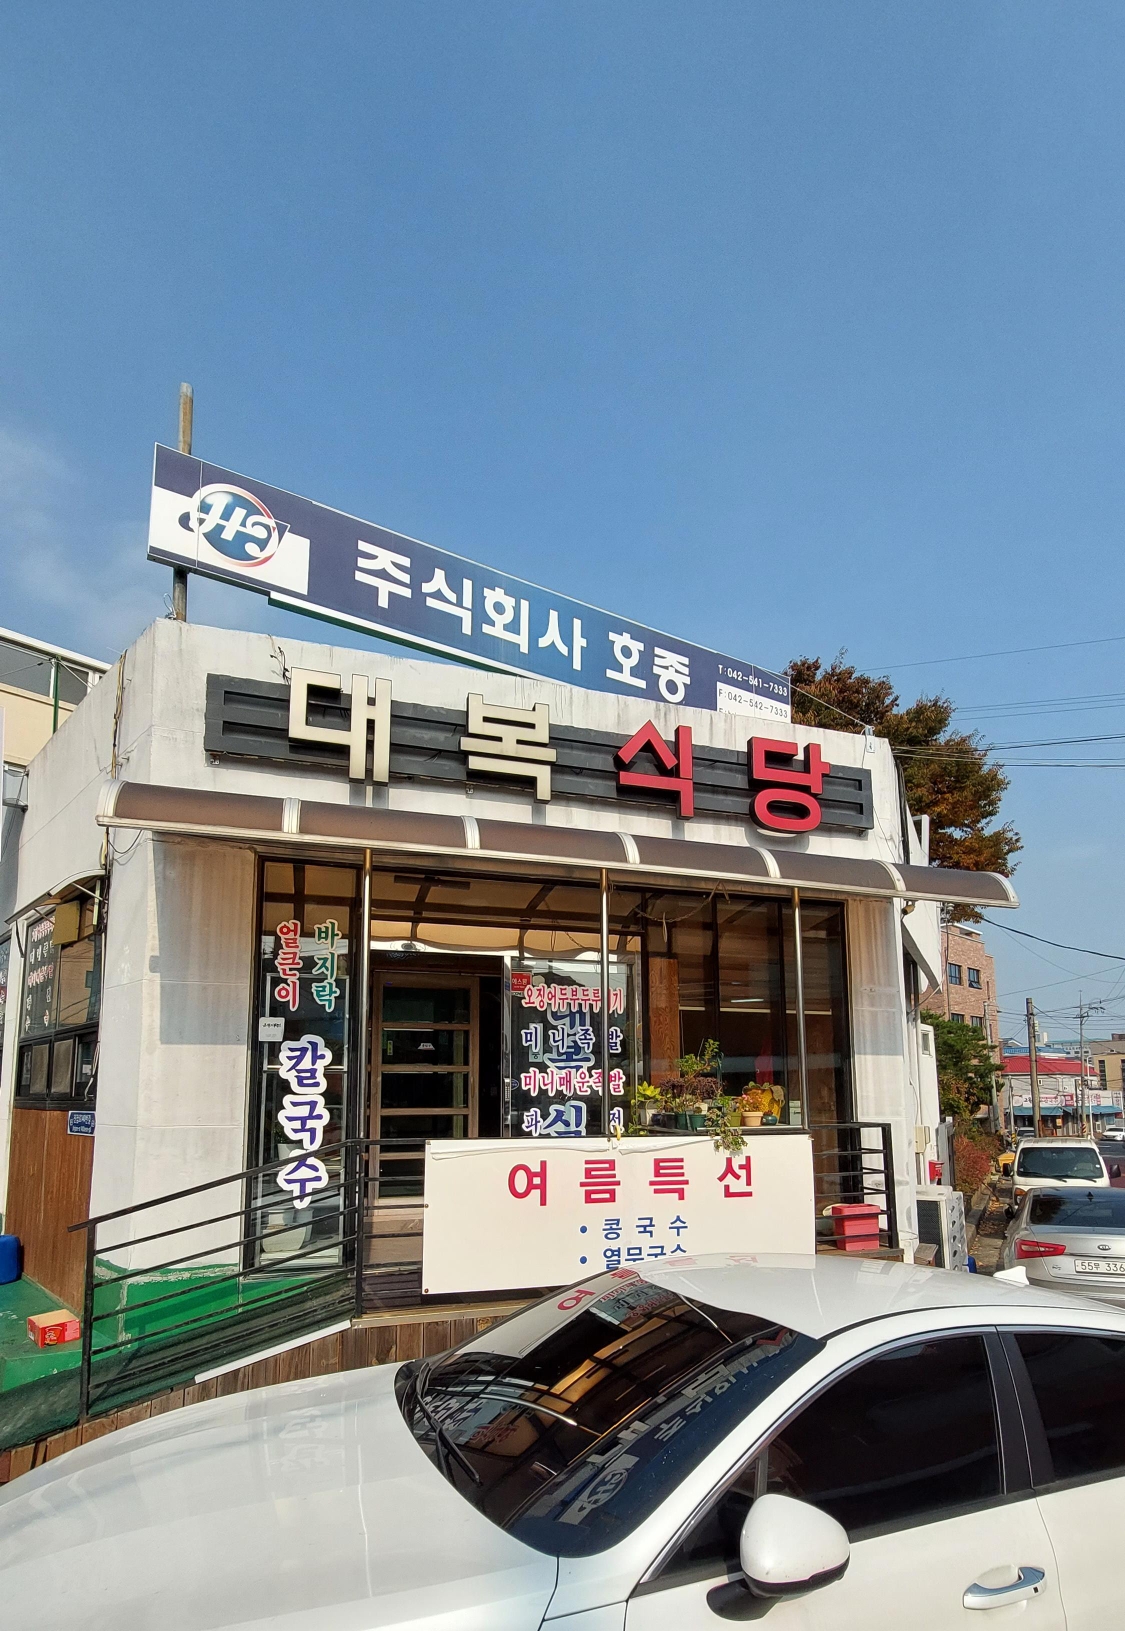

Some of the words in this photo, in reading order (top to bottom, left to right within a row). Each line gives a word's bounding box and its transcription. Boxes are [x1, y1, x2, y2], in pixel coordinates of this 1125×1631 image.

[354, 538, 588, 672] 주식회사
[604, 630, 692, 704] 호종
[717, 664, 788, 697] T:042-541-7333
[718, 688, 788, 719] F:042-542-7333
[288, 666, 829, 834] 대복식당
[275, 920, 302, 1011] 얼큰이
[313, 920, 341, 1011] 바지락
[523, 986, 624, 1012] 오징어두부두루기
[523, 1026, 622, 1052] 미니족발
[522, 1069, 624, 1095] 미니매운족발
[278, 1037, 332, 1209] 칼국수
[508, 1155, 754, 1206] 여름특선
[602, 1214, 688, 1241] 콩국수
[1081, 1262, 1101, 1272] 55무
